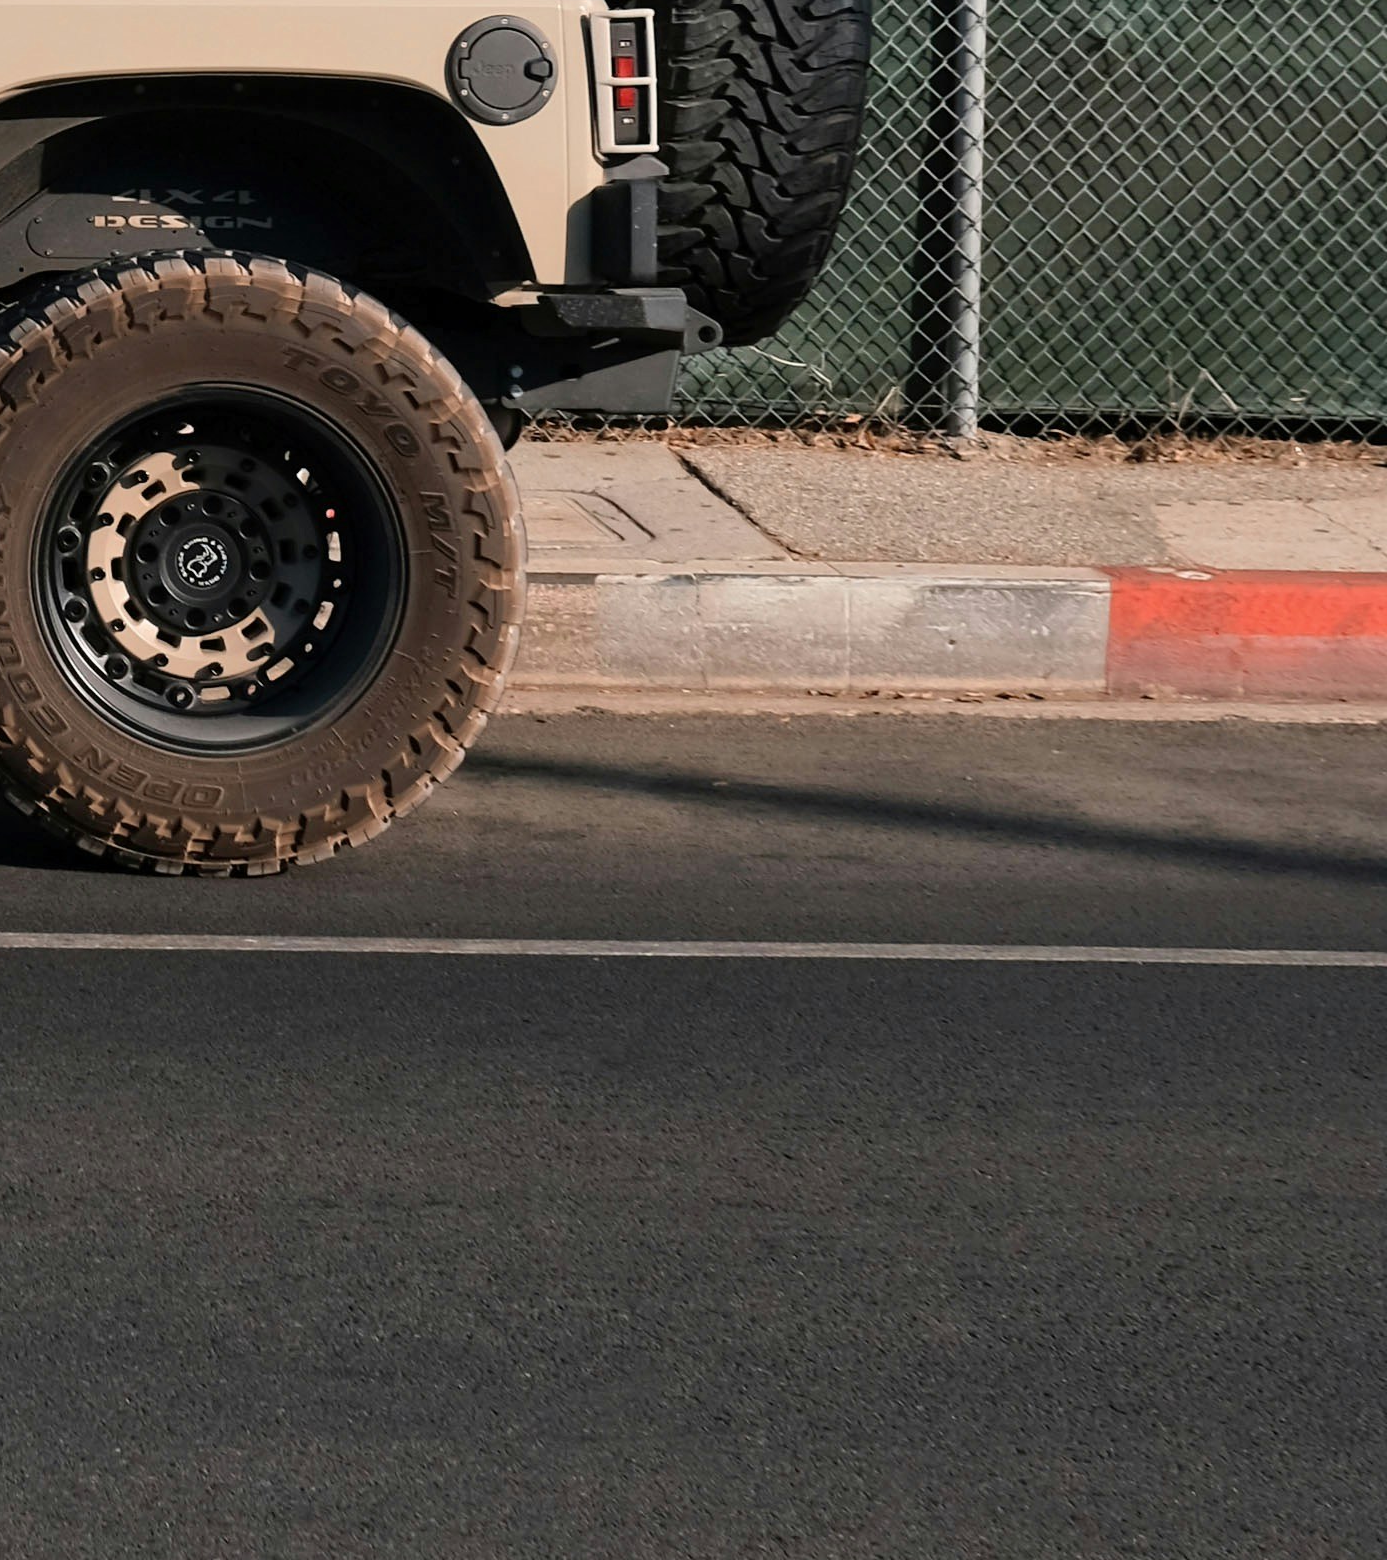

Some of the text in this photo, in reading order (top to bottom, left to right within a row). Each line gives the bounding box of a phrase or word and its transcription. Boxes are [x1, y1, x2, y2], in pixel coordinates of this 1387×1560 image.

[93, 215, 273, 229] DESIGN
[281, 346, 421, 458] TOYO
[420, 491, 460, 599] M/T
[74, 743, 225, 809] OPEN
